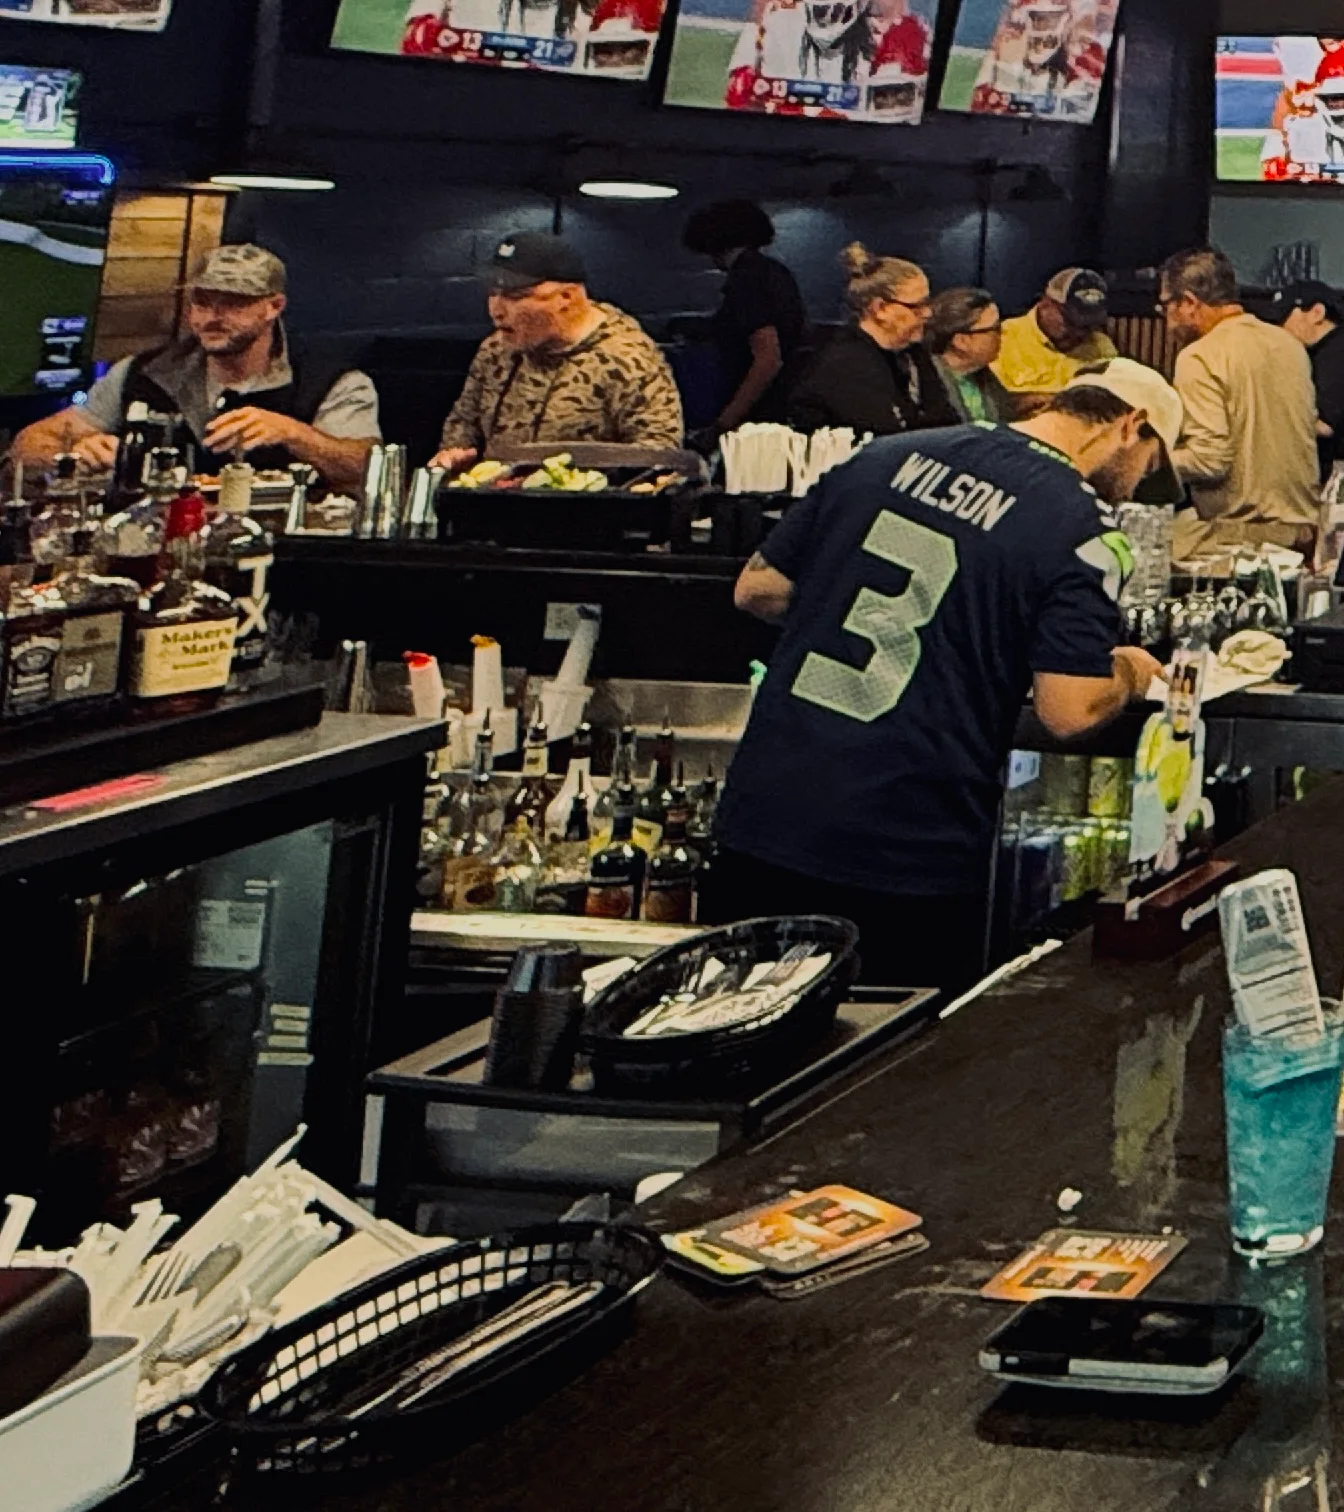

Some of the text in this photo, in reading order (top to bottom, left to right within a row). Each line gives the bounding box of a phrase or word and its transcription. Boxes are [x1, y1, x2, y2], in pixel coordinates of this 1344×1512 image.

[532, 40, 554, 59] 21
[890, 450, 1017, 532] WILSON
[790, 508, 958, 723] 3
[181, 640, 229, 656] Mark
